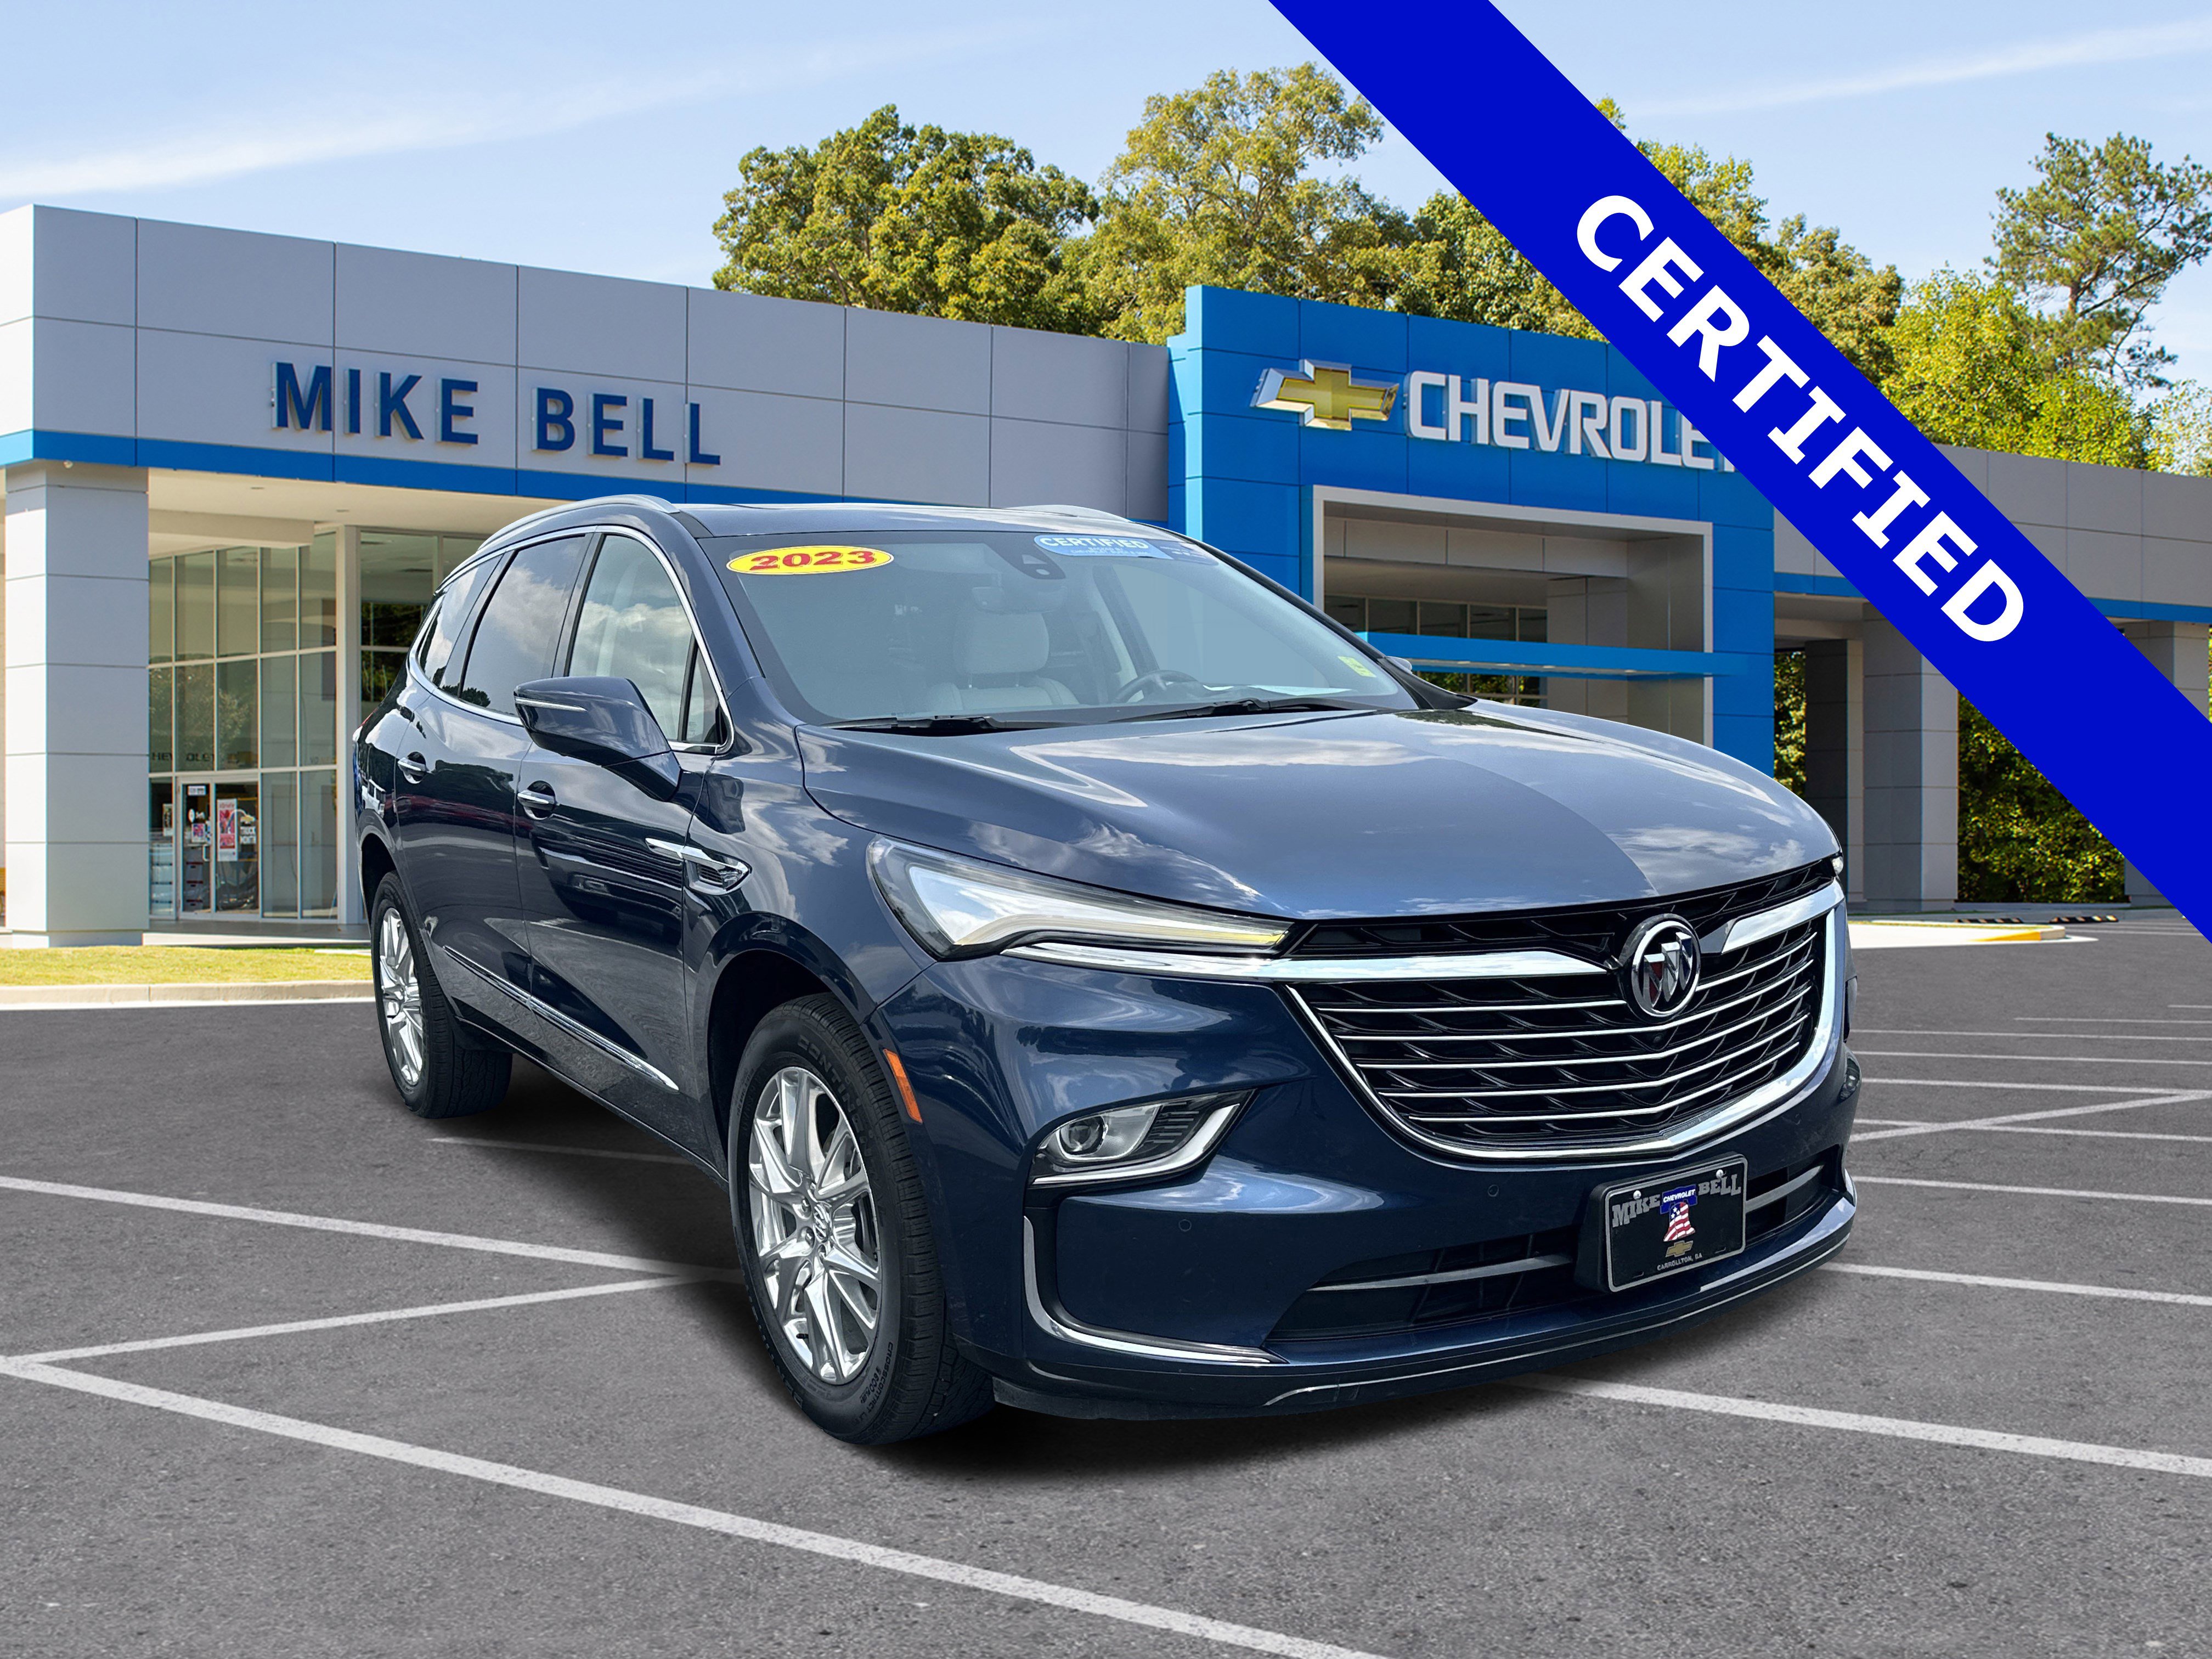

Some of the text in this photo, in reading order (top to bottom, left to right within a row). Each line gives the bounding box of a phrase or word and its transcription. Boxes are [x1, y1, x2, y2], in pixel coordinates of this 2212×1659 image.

[273, 362, 721, 466] MIKE BELL
[1404, 370, 1735, 473] CHEVROLE
[750, 551, 874, 570] 2023
[1040, 537, 1149, 549] CERTIFIED
[1612, 1174, 1741, 1227] MIKE BELL
[1663, 1189, 1696, 1203] CHEVROLET
